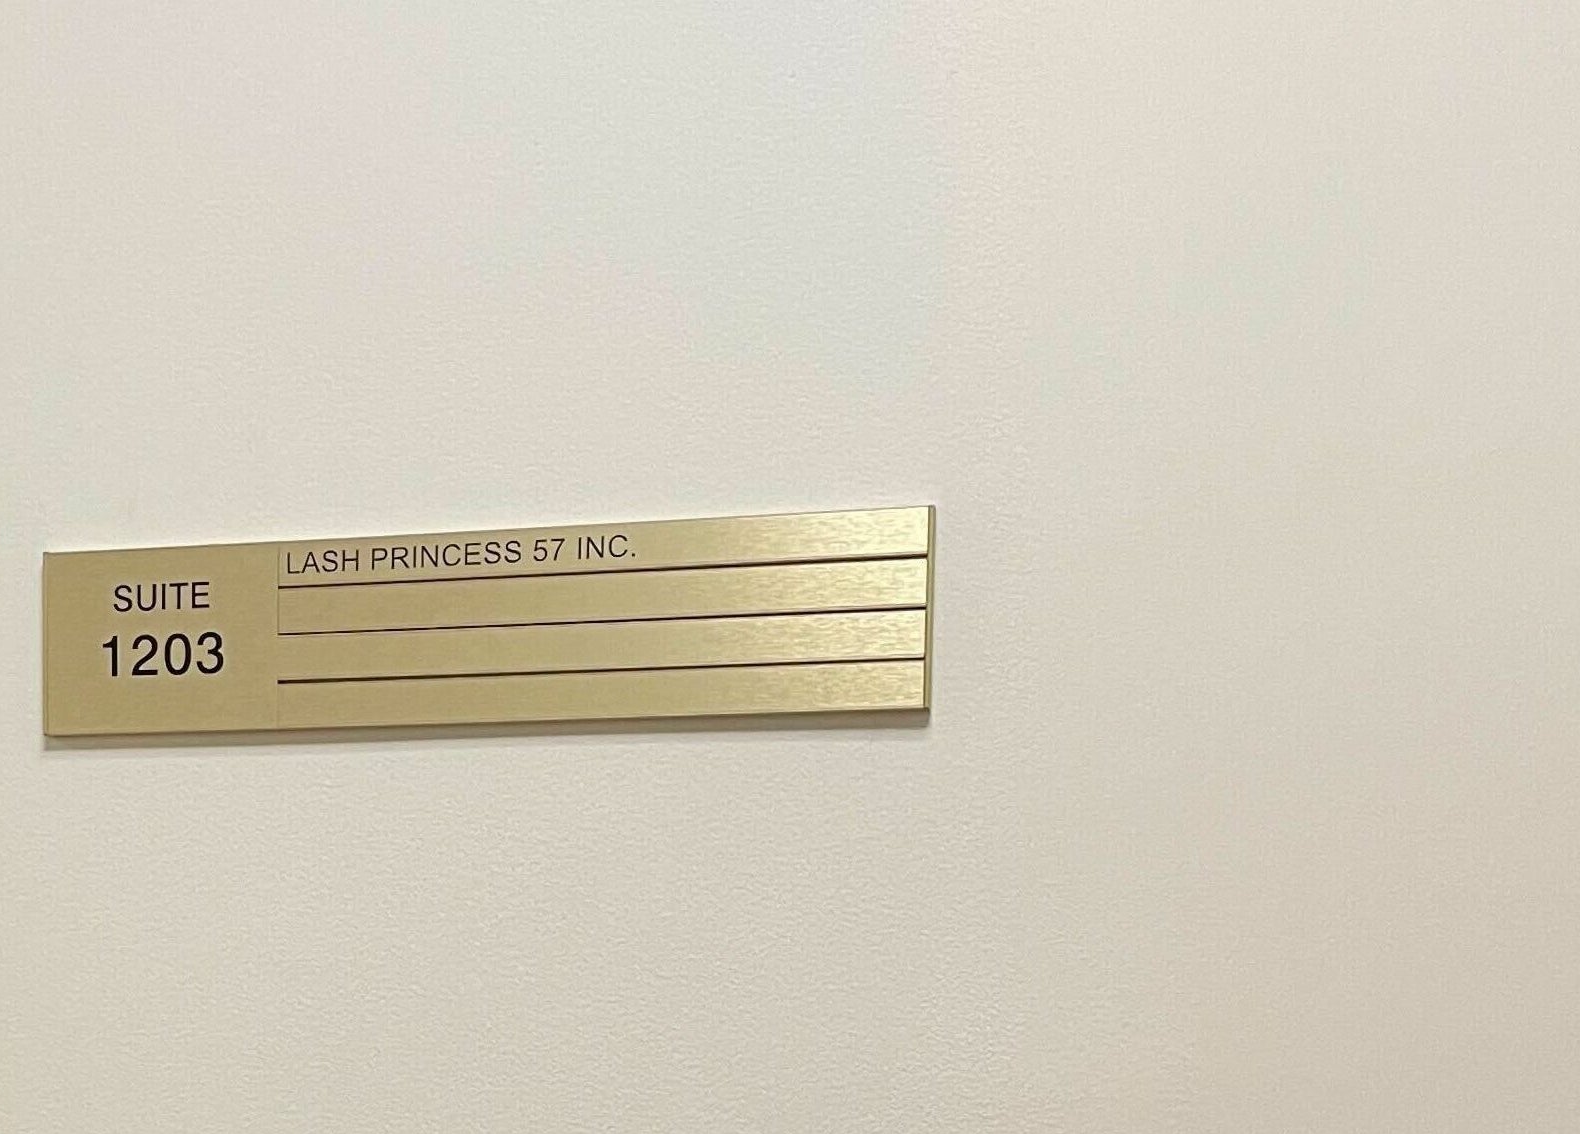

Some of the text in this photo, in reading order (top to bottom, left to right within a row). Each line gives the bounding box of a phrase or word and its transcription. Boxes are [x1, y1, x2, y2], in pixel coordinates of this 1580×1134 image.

[286, 533, 638, 575] LASH PRINCESS 57 INC.
[112, 581, 211, 613] SUITE
[101, 631, 225, 677] 1203
